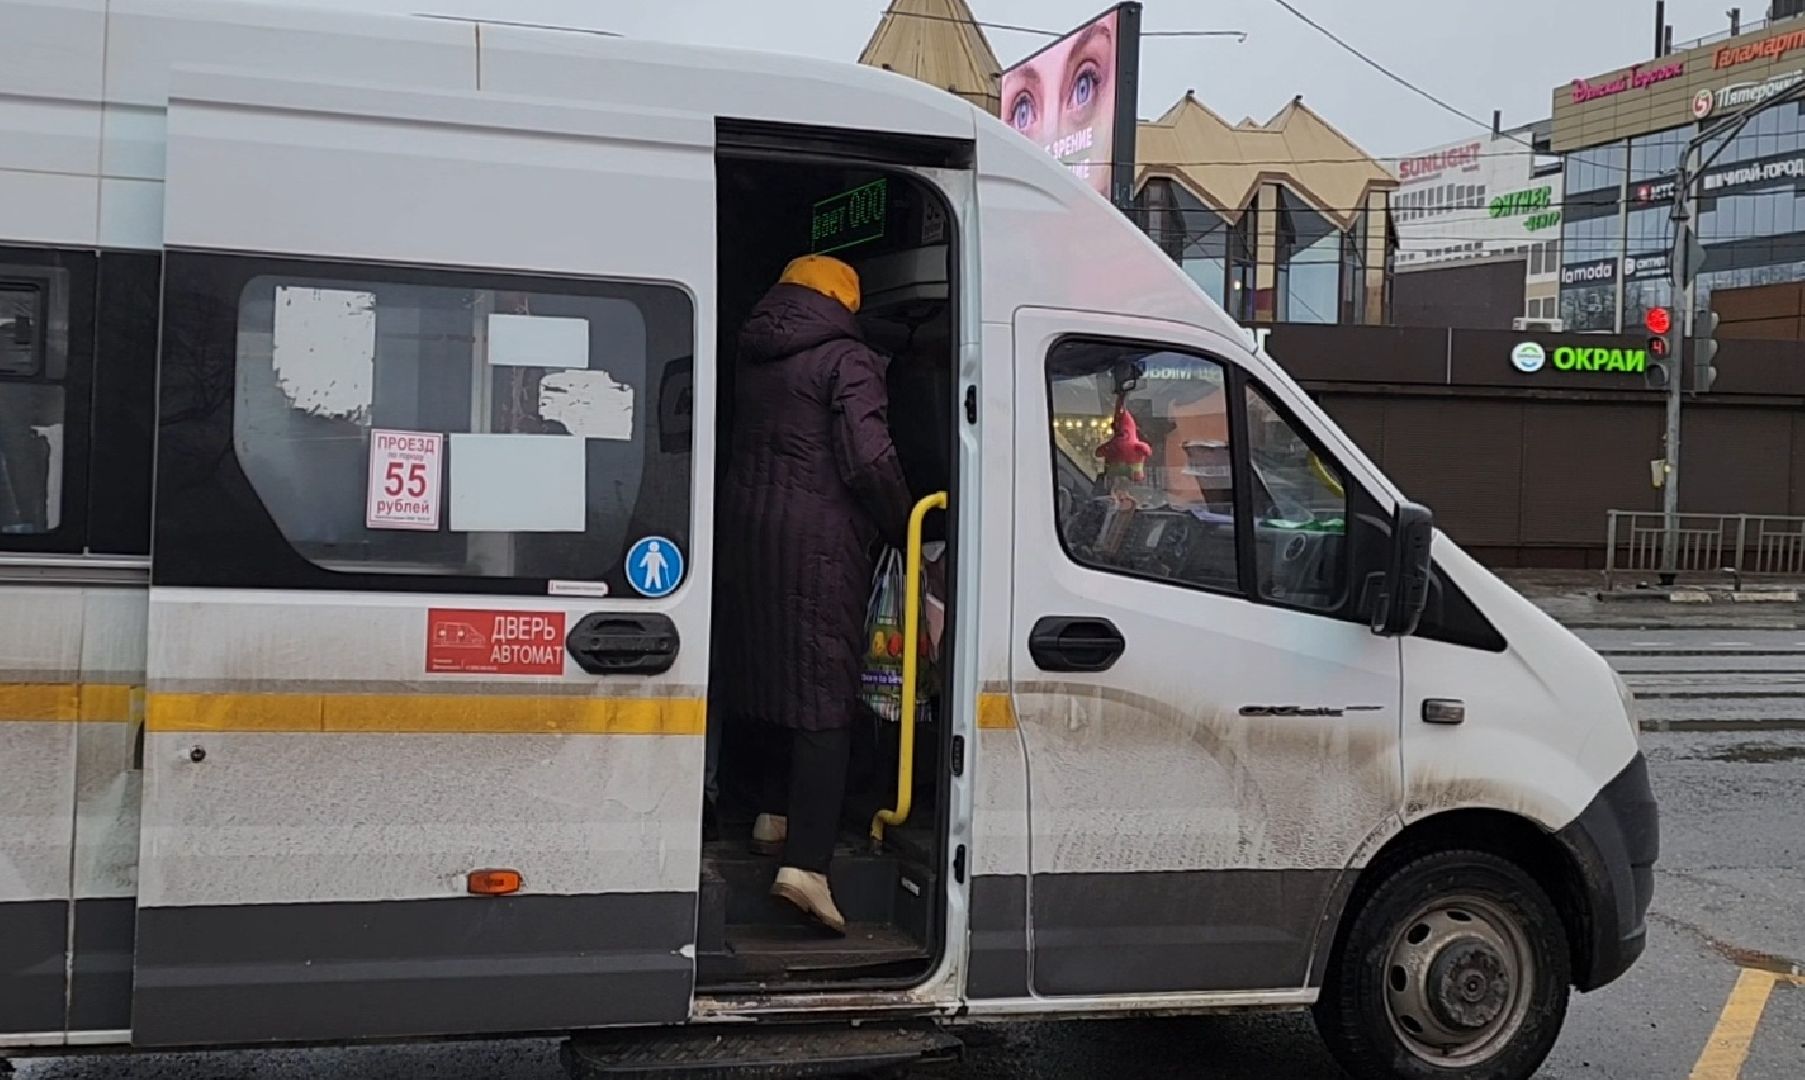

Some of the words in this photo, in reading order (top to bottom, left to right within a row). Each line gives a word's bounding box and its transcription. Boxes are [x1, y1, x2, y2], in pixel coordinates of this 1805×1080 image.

[1399, 142, 1481, 179] SUNLIGHT
[1722, 158, 1804, 187] ЧИТАЙ-ГОРОД
[1561, 262, 1612, 283] lamoda
[377, 436, 434, 454] ПРОЕЗД
[384, 462, 426, 497] 55
[377, 499, 430, 514] рублей
[491, 616, 556, 643] ДВЕРЬ
[490, 645, 563, 664] АВТОМАТ
